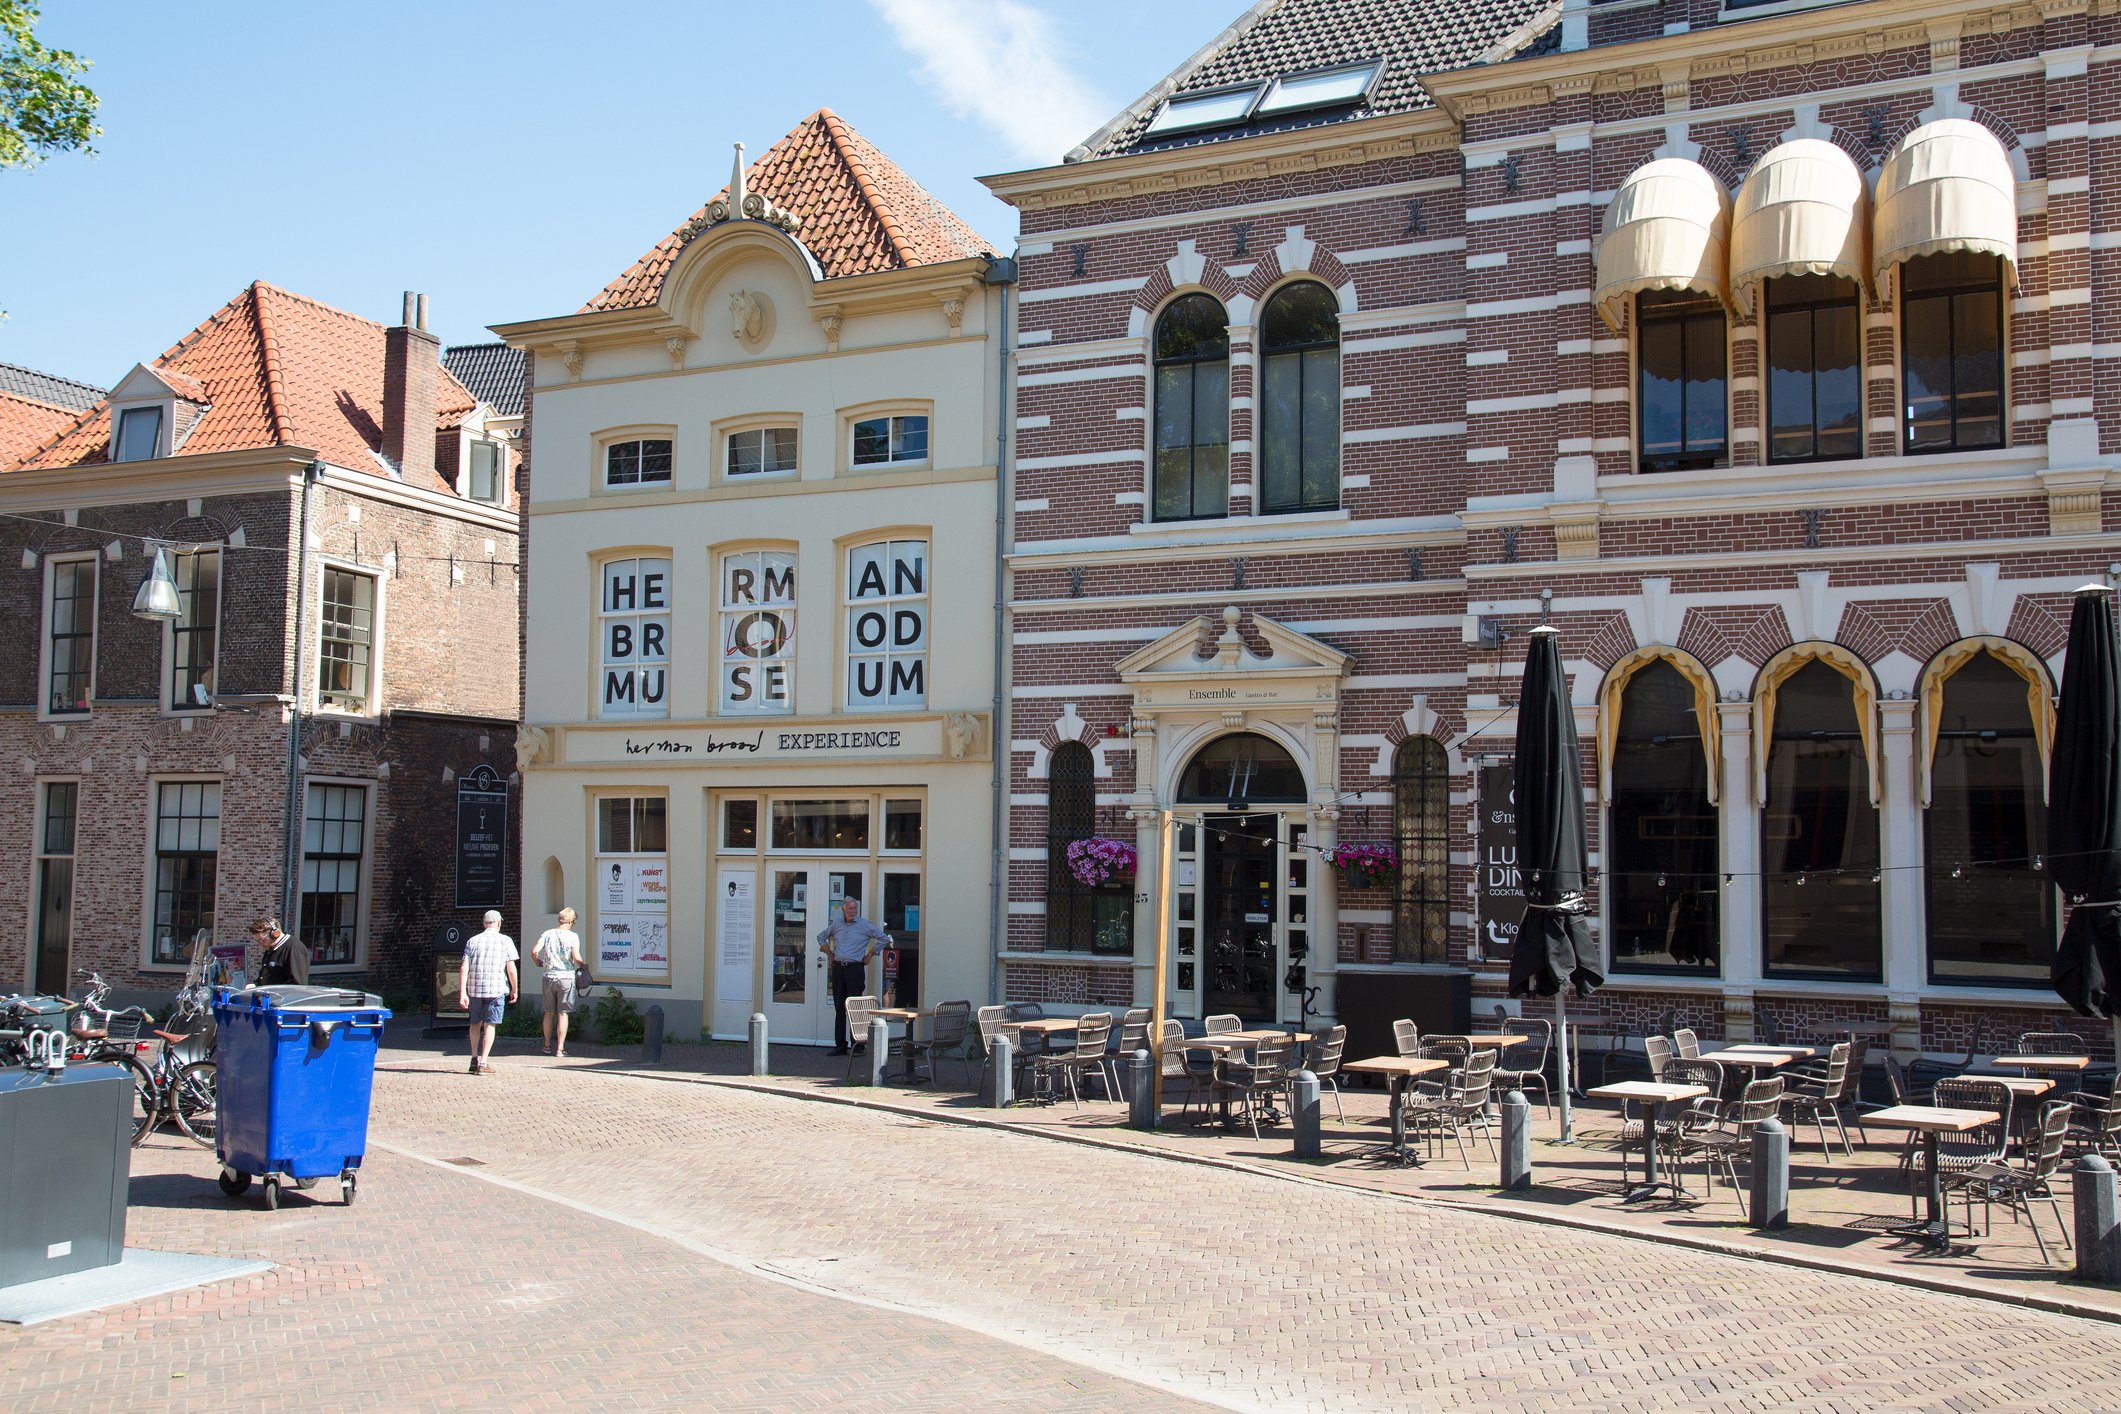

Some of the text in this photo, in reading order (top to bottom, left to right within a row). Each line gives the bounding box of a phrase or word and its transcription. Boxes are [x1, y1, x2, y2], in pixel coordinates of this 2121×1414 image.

[613, 558, 922, 609] HE RM AN
[611, 623, 664, 657] BR
[856, 610, 921, 647] OD
[606, 660, 923, 704] MU SE UM
[1189, 688, 1237, 699] Ensemble
[777, 731, 901, 751] EXPERIENCE
[1135, 893, 1148, 903] 25
